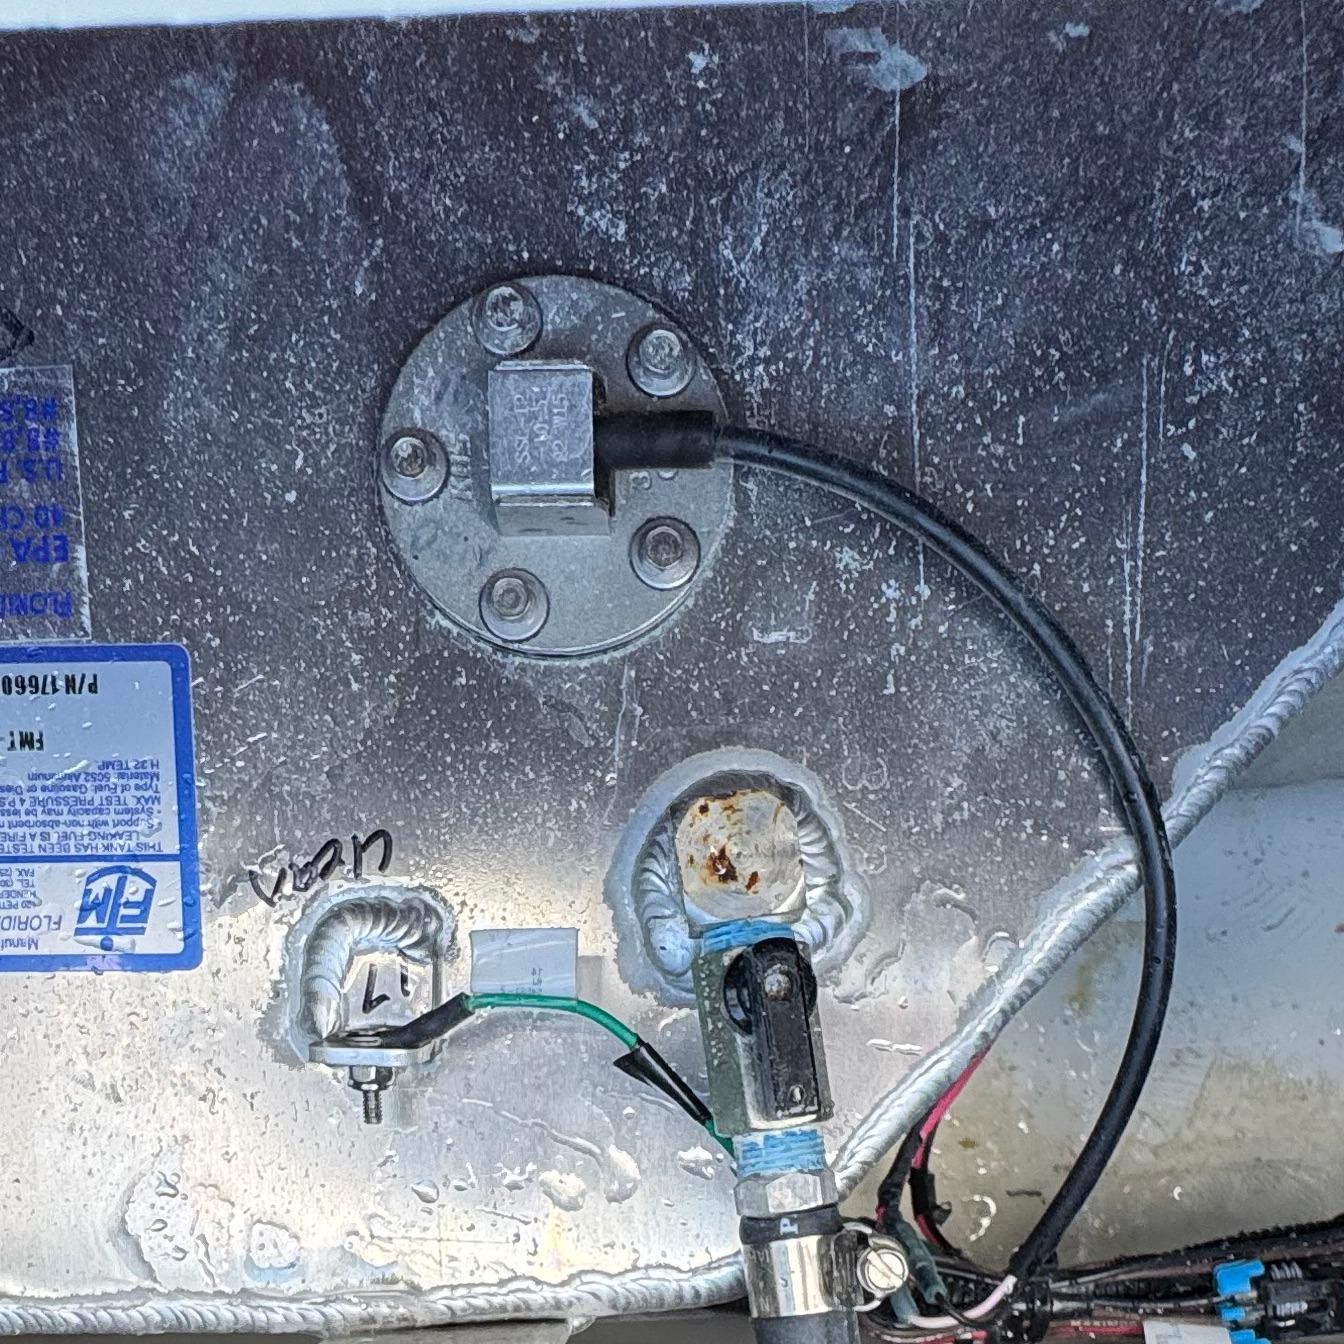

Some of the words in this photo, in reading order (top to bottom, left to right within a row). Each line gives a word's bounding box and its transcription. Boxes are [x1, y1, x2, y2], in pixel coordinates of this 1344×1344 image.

[11, 535, 69, 565] EPA
[114, 771, 160, 781] Material:
[26, 785, 37, 793] or
[40, 784, 88, 794] Gasoline
[120, 784, 131, 794] of
[134, 783, 160, 793] Type
[19, 797, 26, 806] 4
[30, 796, 94, 806] PRESSURE
[98, 795, 127, 805] TEST
[0, 808, 21, 817] less
[25, 808, 37, 817] be
[41, 806, 63, 816] may
[67, 806, 111, 817] capacity
[114, 806, 154, 817] System
[8, 820, 84, 829] non-absorbent
[88, 819, 109, 829] with
[0, 832, 26, 842] FIRE
[29, 832, 37, 841] A
[40, 832, 50, 841] IS
[54, 831, 84, 841] FUEL
[88, 831, 139, 841] LEAKING
[38, 843, 70, 853] BEEN
[75, 843, 98, 852] HAS
[101, 842, 132, 852] TANK
[133, 842, 163, 852] THIS
